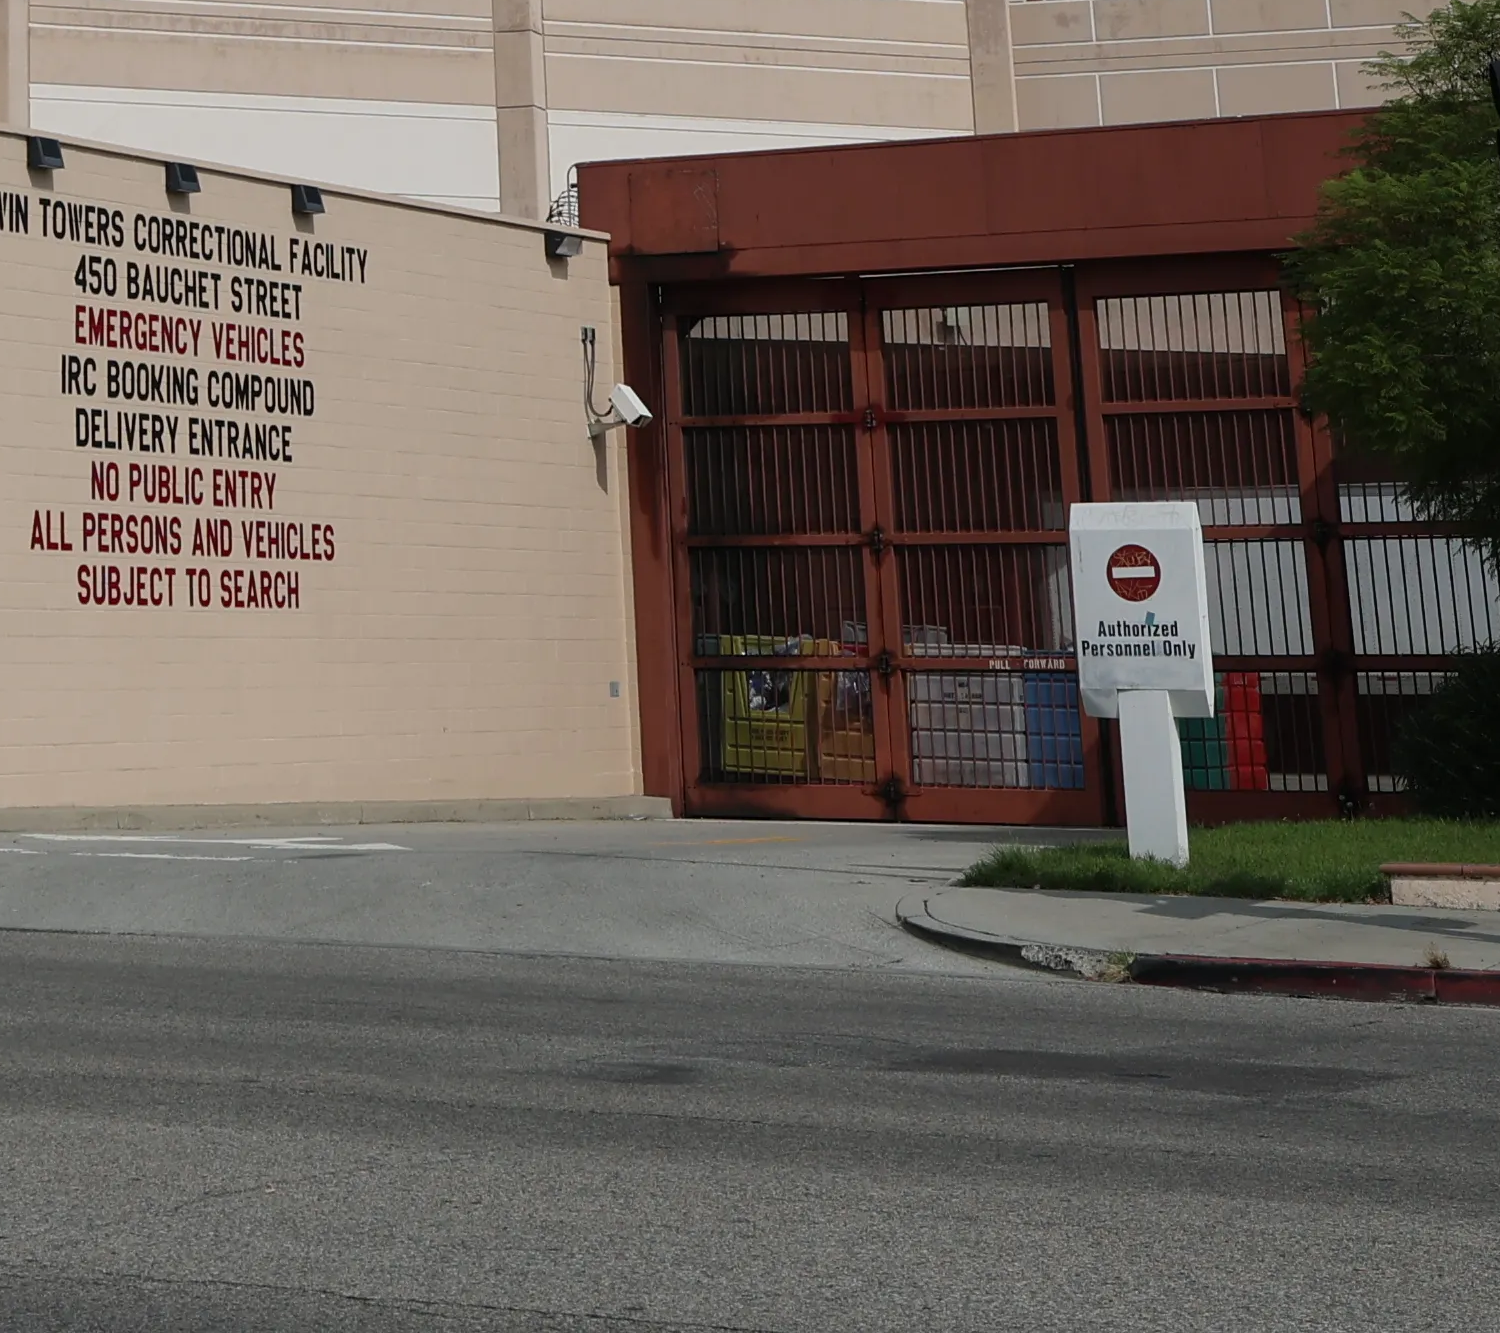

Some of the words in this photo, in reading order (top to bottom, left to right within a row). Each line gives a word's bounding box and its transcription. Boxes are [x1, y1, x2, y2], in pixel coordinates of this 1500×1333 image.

[39, 198, 123, 247] TOWERS
[134, 214, 281, 271] CORRECTIONAL
[290, 238, 367, 283] FACILITY
[75, 255, 116, 296] 450
[127, 262, 221, 310] BAUCHET
[231, 276, 301, 320] STREET
[76, 305, 201, 356] EMERGENCY
[212, 322, 304, 368] VEHICLES
[62, 355, 96, 395] IRC
[108, 360, 198, 405] BOOKING
[208, 371, 314, 416] COMPOUND
[76, 408, 178, 453] DELIVERY
[189, 418, 292, 462] ENTRANCE
[92, 461, 119, 501] NO
[130, 463, 203, 505] PUBLIC
[213, 469, 276, 509] ENTRY
[31, 510, 72, 551] ALL
[83, 513, 181, 554] PERSONS
[192, 518, 232, 557] AND
[242, 521, 334, 561] VEHICLES
[78, 565, 176, 606] SUBJECT
[186, 569, 210, 607] TO
[221, 570, 299, 608] SEARCH
[1081, 640, 1155, 657] Personnel
[1163, 640, 1195, 659] Only
[1098, 620, 1178, 637] Authorized
[989, 659, 1010, 670] PULL
